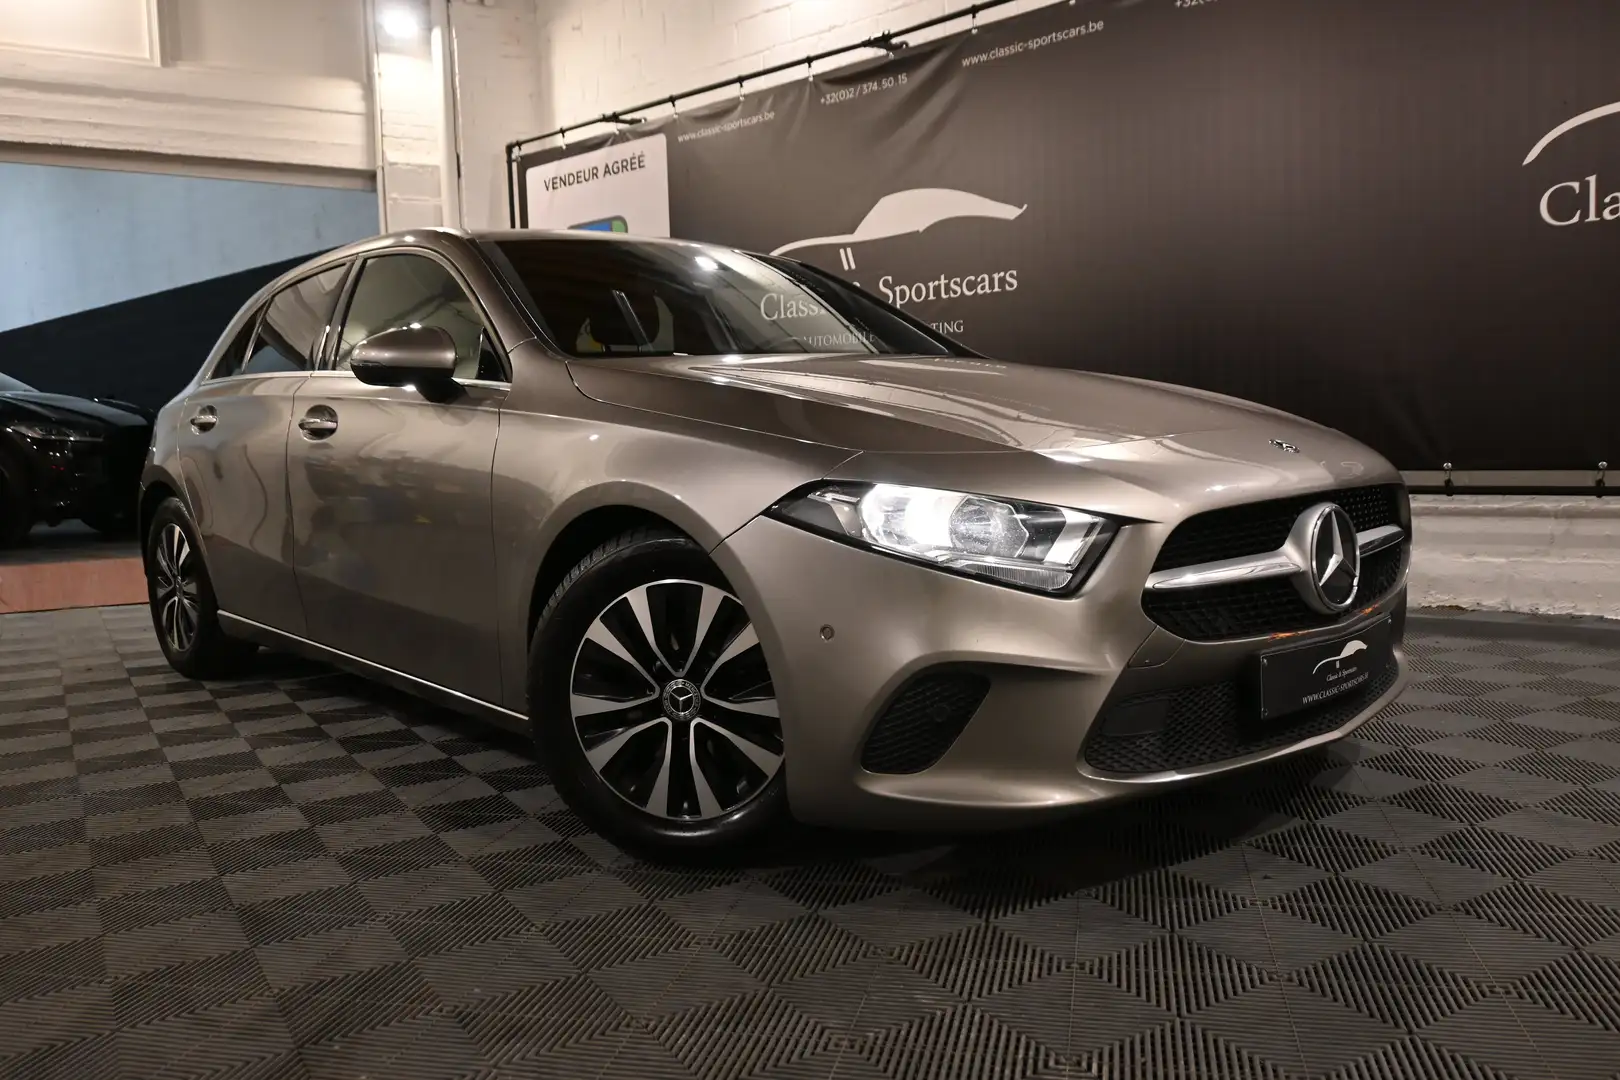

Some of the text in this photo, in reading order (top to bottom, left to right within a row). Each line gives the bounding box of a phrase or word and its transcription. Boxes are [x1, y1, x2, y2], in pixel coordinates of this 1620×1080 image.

[961, 19, 1105, 68] www.classic-sportscars.be
[677, 110, 775, 143] www.classic-sportscars.be
[543, 150, 646, 192] VENDEUR AGRÉÉ
[1539, 173, 1620, 226] Cla
[878, 268, 1018, 309] Sportscars
